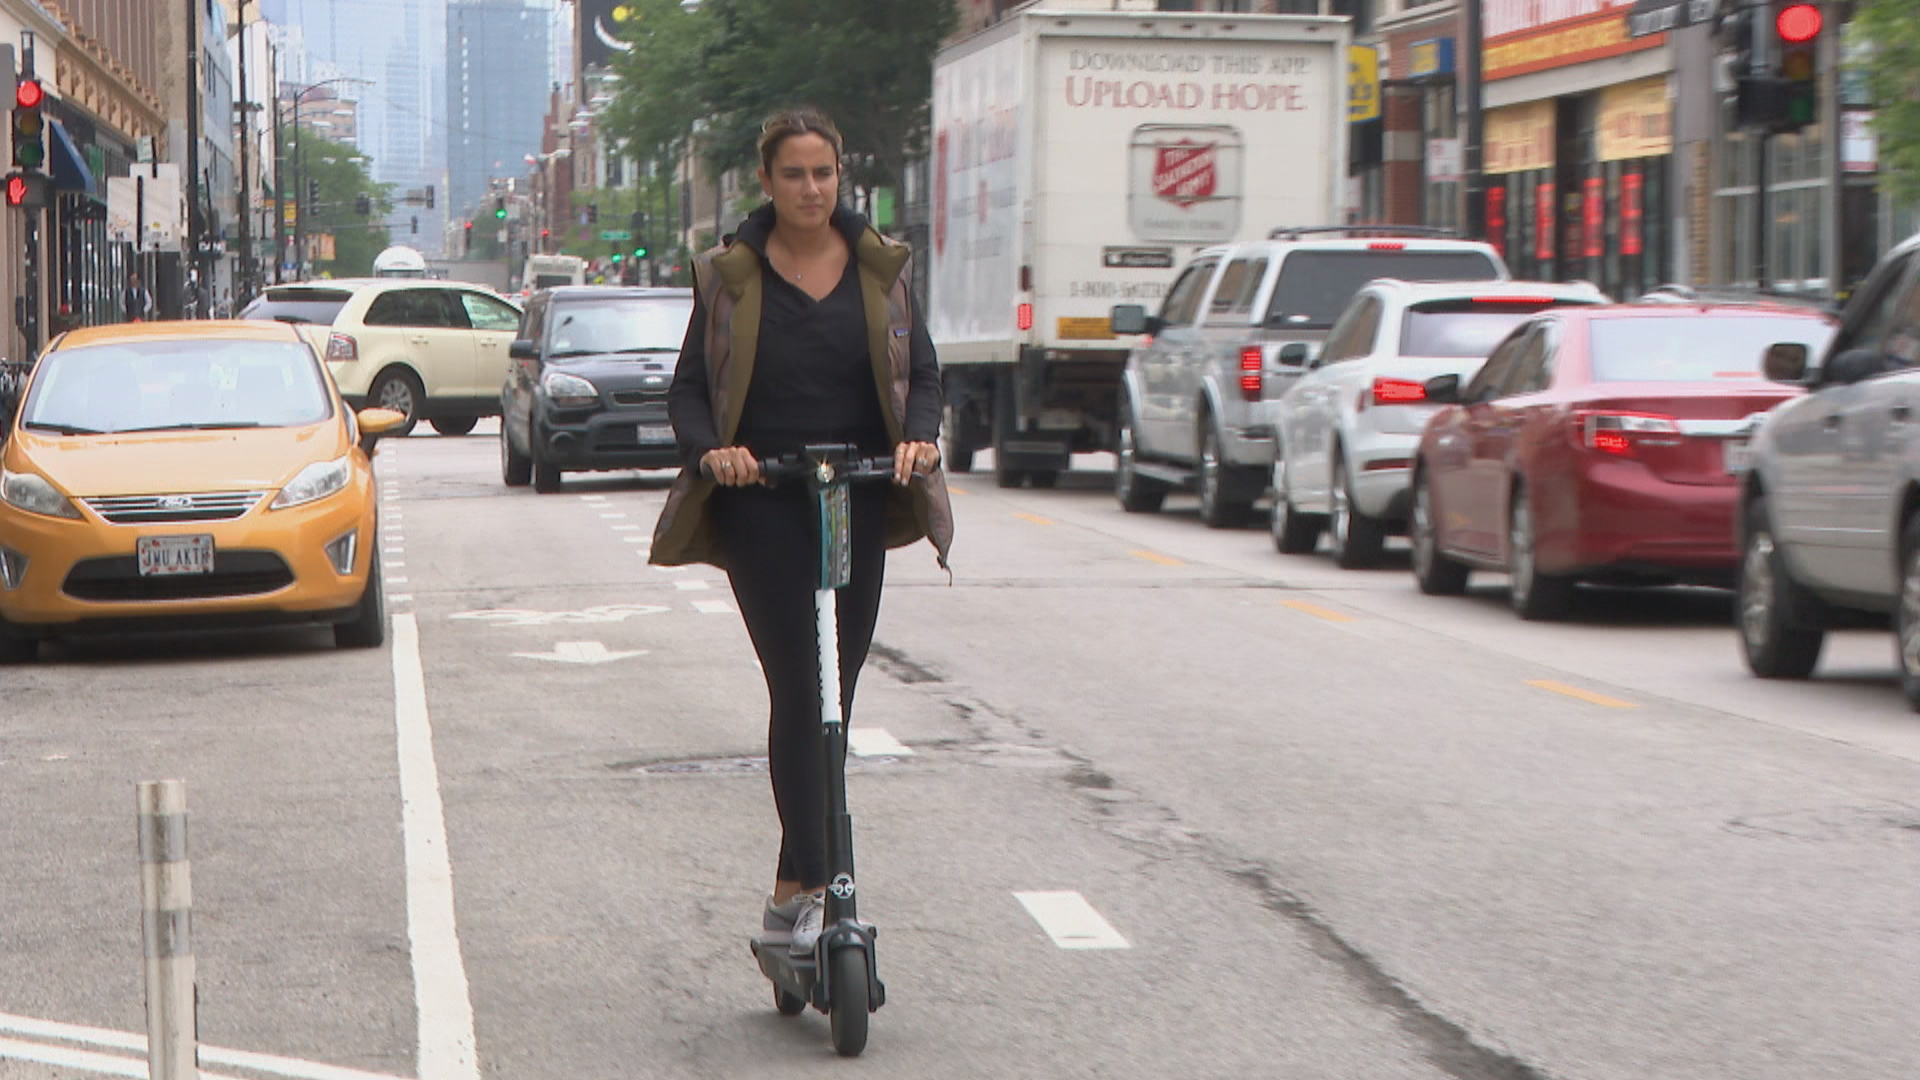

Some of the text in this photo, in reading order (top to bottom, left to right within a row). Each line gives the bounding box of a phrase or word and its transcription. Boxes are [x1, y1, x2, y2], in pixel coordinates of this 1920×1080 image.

[1069, 49, 1313, 75] DOWNLOAD THIS APP
[1065, 75, 1205, 109] UPLOAD
